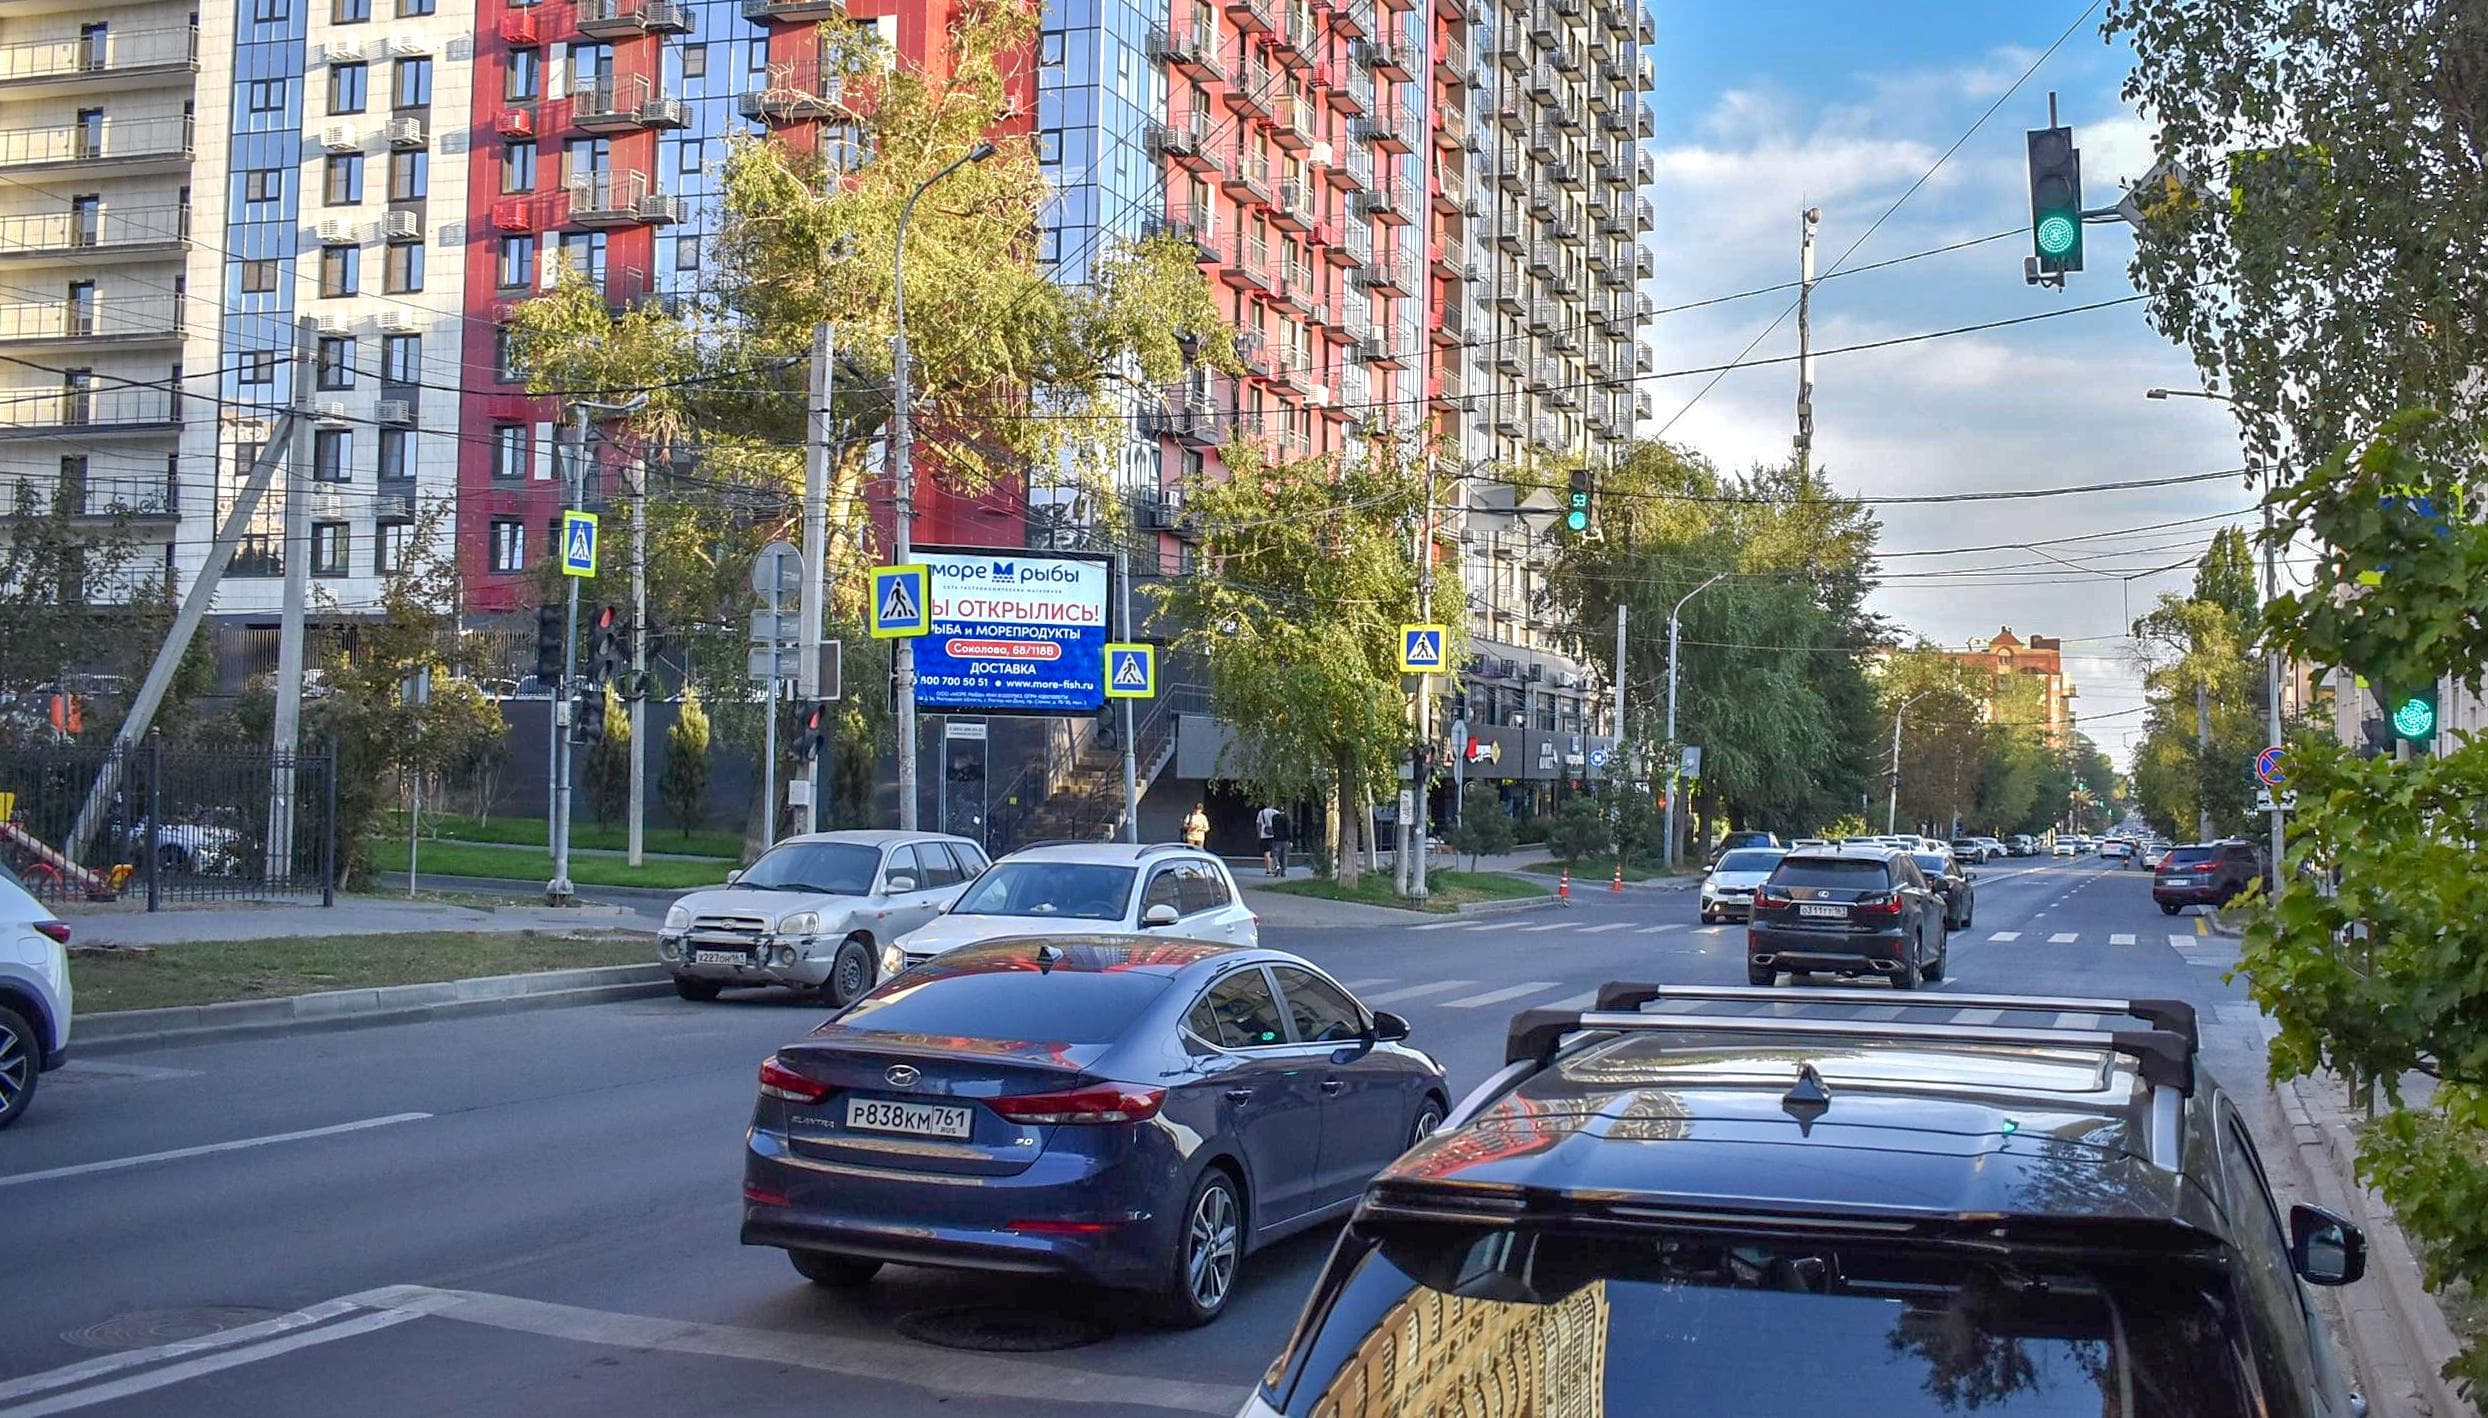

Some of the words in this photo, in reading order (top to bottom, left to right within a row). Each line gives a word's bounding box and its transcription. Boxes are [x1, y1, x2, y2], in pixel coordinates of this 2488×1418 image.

[1572, 494, 1586, 507] 53
[931, 564, 988, 581] море
[1020, 565, 1080, 584] рыбы
[931, 599, 950, 617] Ы
[957, 600, 1100, 622] ОТКРЫЛИСЬ!
[975, 626, 1081, 641] МОРЕПРОДУКТЫ
[953, 643, 1010, 656] Соколово,
[969, 662, 1037, 675] ДОСТАВКА
[942, 676, 961, 686] 700
[962, 677, 976, 687] 50
[977, 678, 989, 687] 51
[1006, 679, 1095, 690] www.more-fish.ru
[853, 1103, 931, 1131] Р838КМ
[935, 1108, 965, 1128] 761
[939, 1126, 957, 1134] RUS
